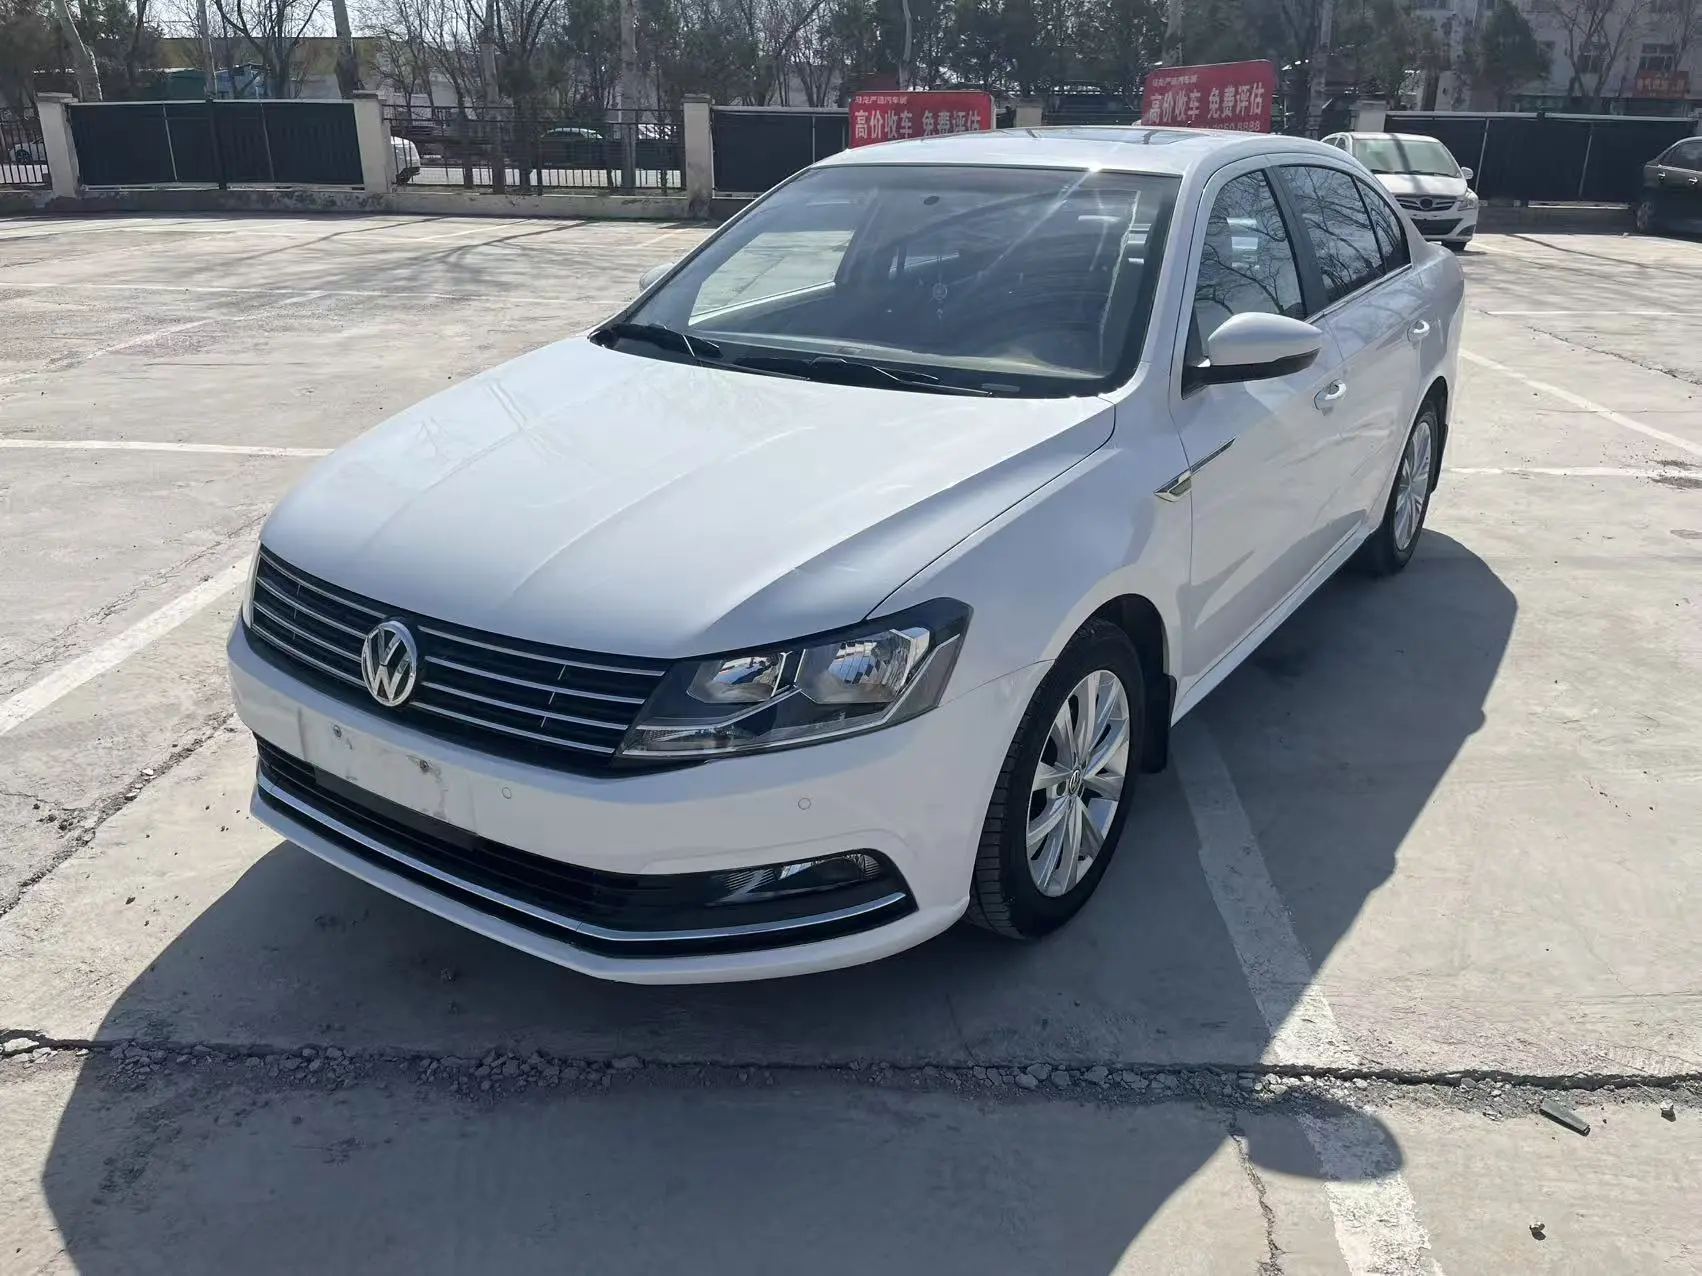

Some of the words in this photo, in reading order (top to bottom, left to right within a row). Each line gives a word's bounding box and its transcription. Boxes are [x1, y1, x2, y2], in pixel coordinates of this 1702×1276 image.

[855, 109, 913, 139] 高价收车
[922, 109, 981, 136] 免费评估
[1149, 89, 1201, 124] 高价收车
[1208, 82, 1264, 118] 免费评估
[361, 621, 417, 707] VW
